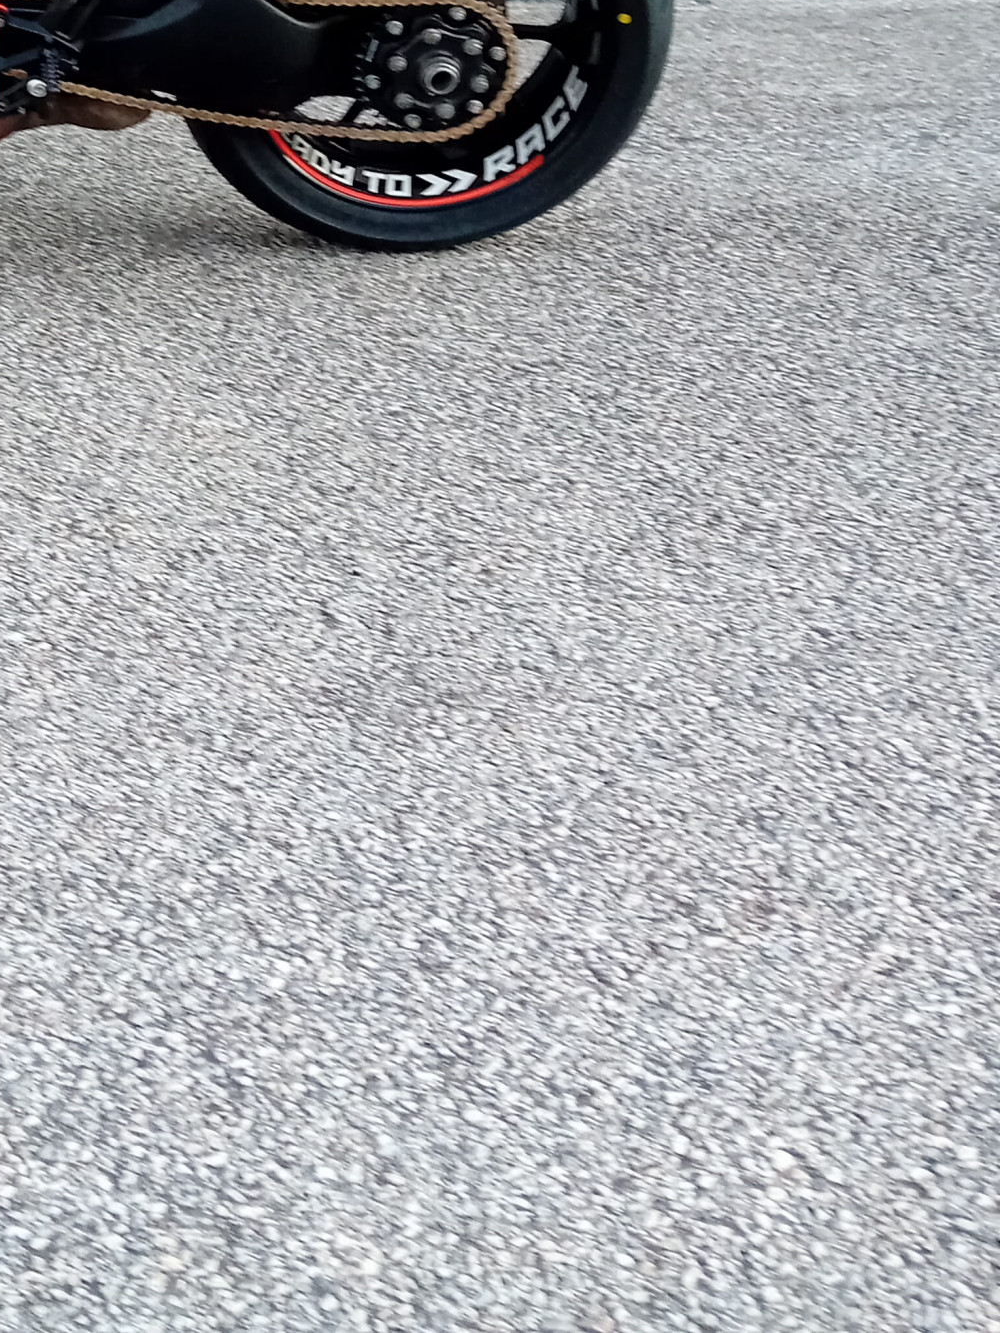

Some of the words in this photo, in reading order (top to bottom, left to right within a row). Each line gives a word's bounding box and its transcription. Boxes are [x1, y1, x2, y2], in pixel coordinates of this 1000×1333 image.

[281, 131, 356, 186] ADY
[361, 170, 412, 197] TO
[483, 65, 588, 182] RACE
